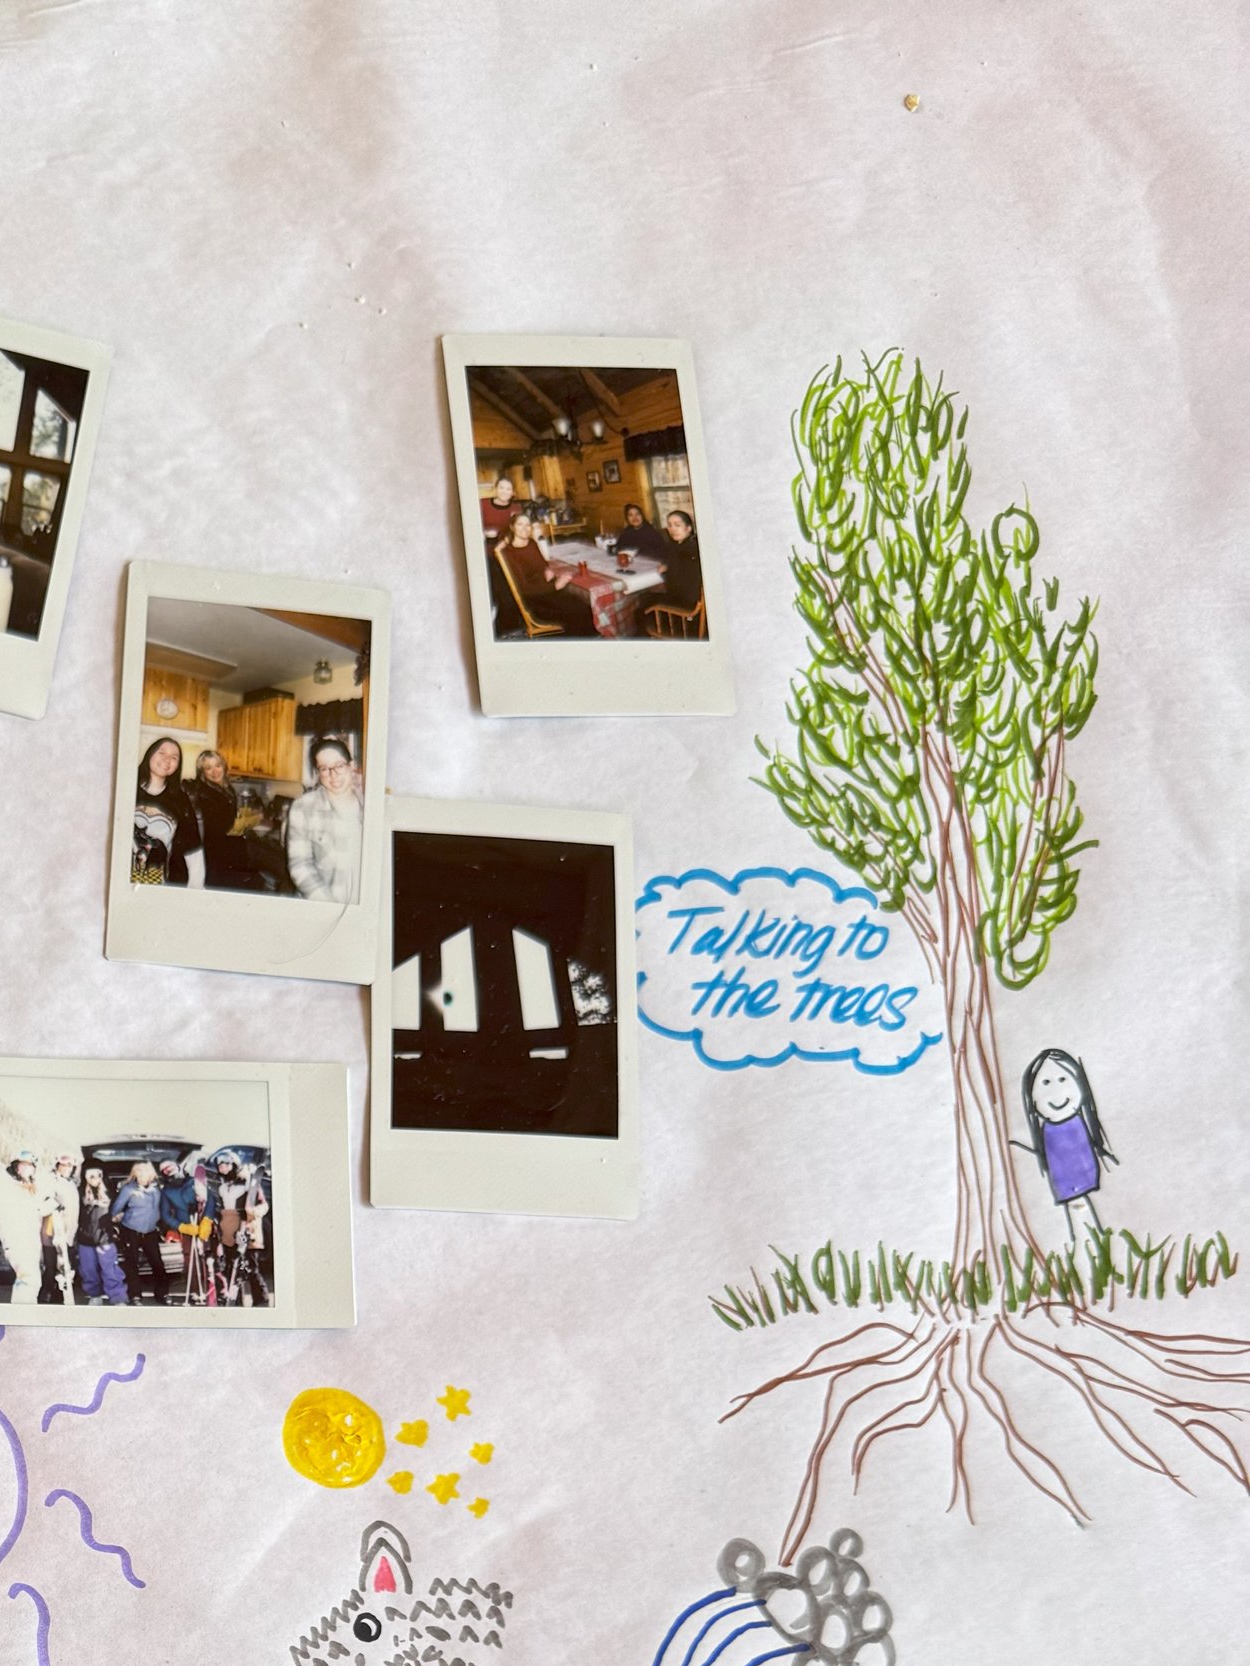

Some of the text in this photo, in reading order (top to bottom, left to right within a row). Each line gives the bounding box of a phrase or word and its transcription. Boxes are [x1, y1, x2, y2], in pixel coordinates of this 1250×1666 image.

[667, 905, 890, 979] Talking to
[691, 966, 919, 1031] the trees
